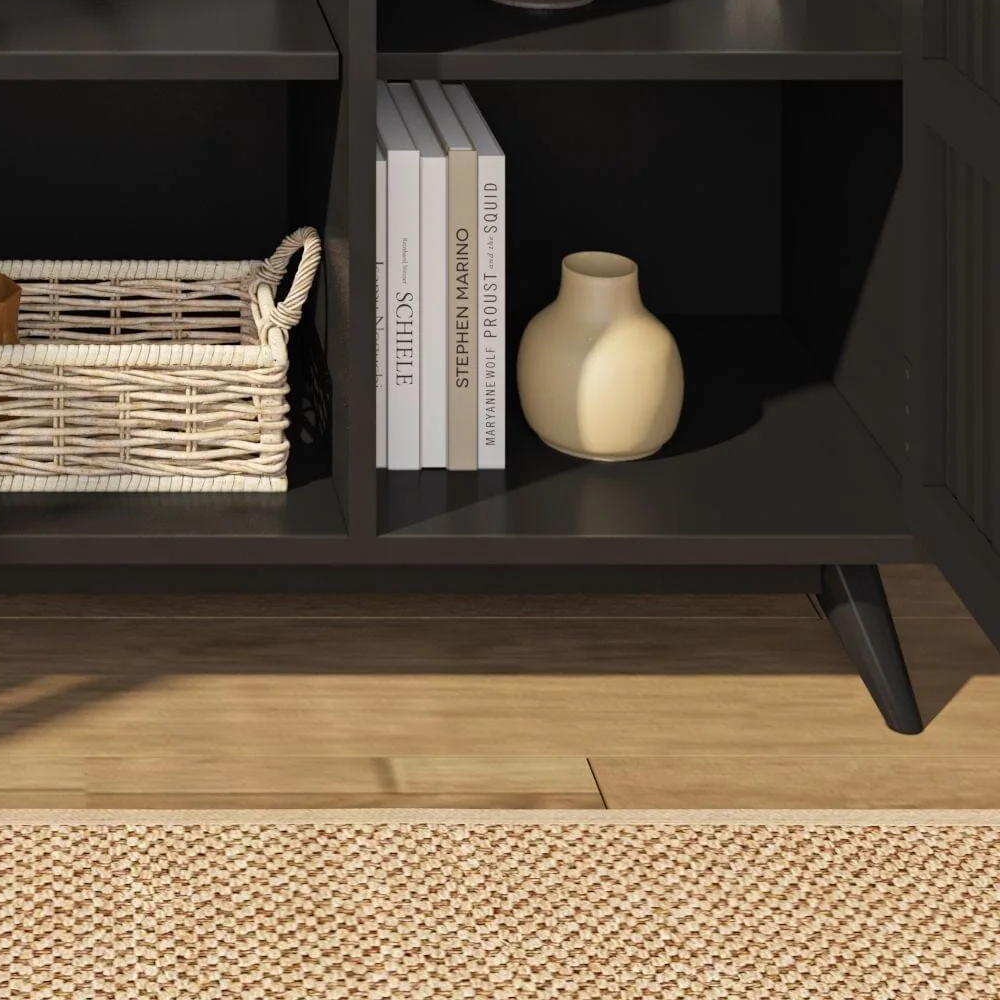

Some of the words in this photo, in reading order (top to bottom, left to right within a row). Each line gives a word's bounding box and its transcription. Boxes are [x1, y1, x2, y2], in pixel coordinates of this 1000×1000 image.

[484, 182, 498, 234] SQUID
[455, 227, 469, 300] MARINO
[484, 272, 498, 338] PROUST
[396, 292, 414, 386] SCHIELE
[455, 306, 469, 388] STEPHEN
[485, 346, 496, 379] WOLF
[485, 381, 496, 446] MARYANNE
